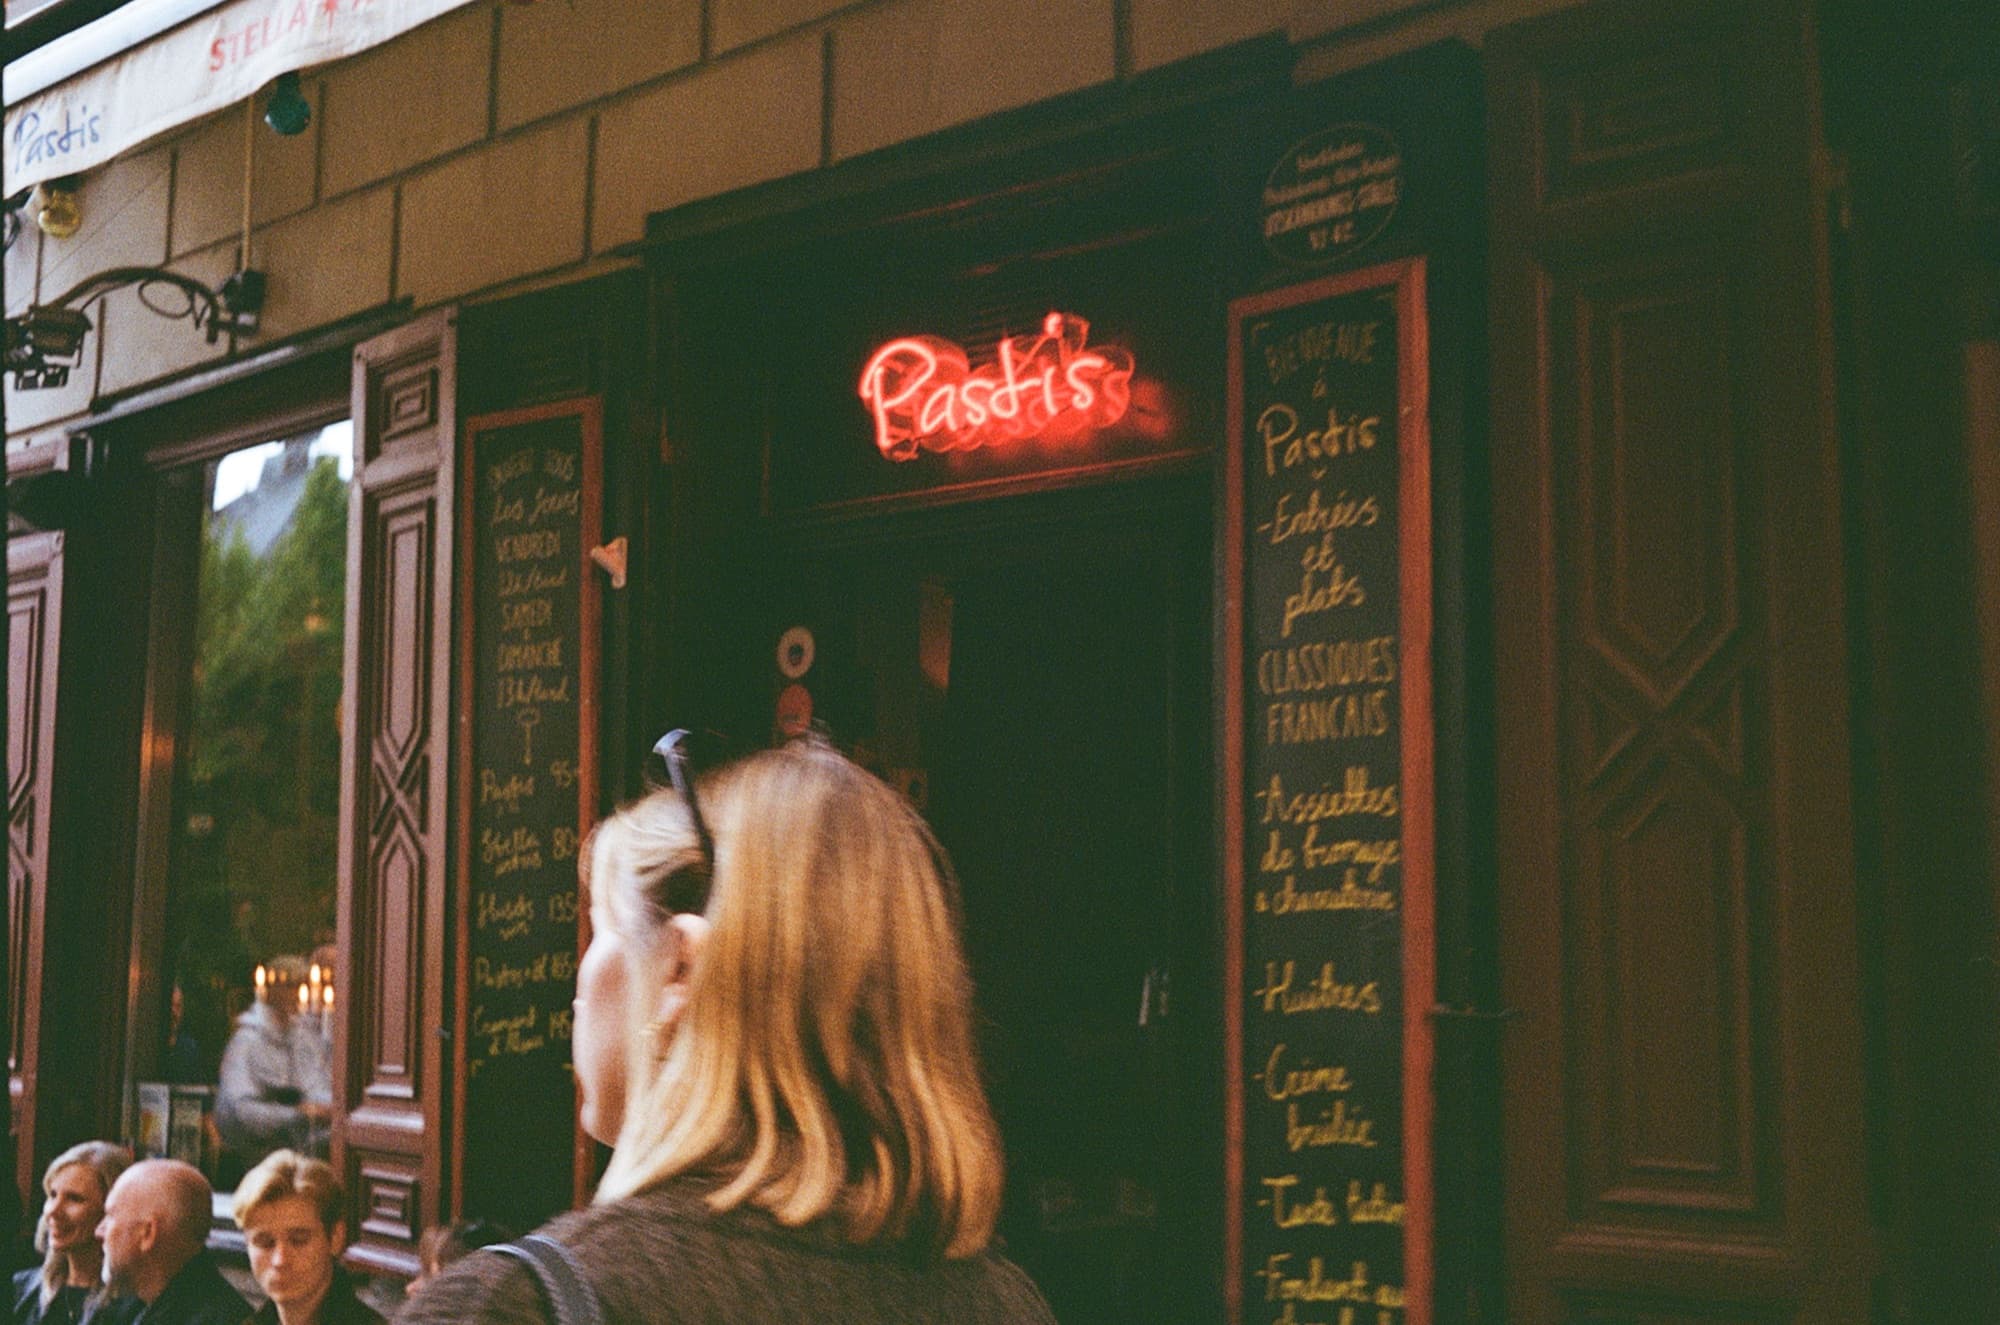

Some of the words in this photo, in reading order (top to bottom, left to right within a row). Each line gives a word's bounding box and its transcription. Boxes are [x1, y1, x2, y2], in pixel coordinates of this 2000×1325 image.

[209, 0, 307, 72] STELLA
[12, 103, 101, 174] Pastis
[859, 311, 1108, 449] Pastis
[1256, 403, 1380, 478] Pastis
[1301, 530, 1338, 573] et
[1281, 564, 1366, 639] plats
[1257, 636, 1397, 695] CLASSIQUES
[1260, 829, 1294, 873] de
